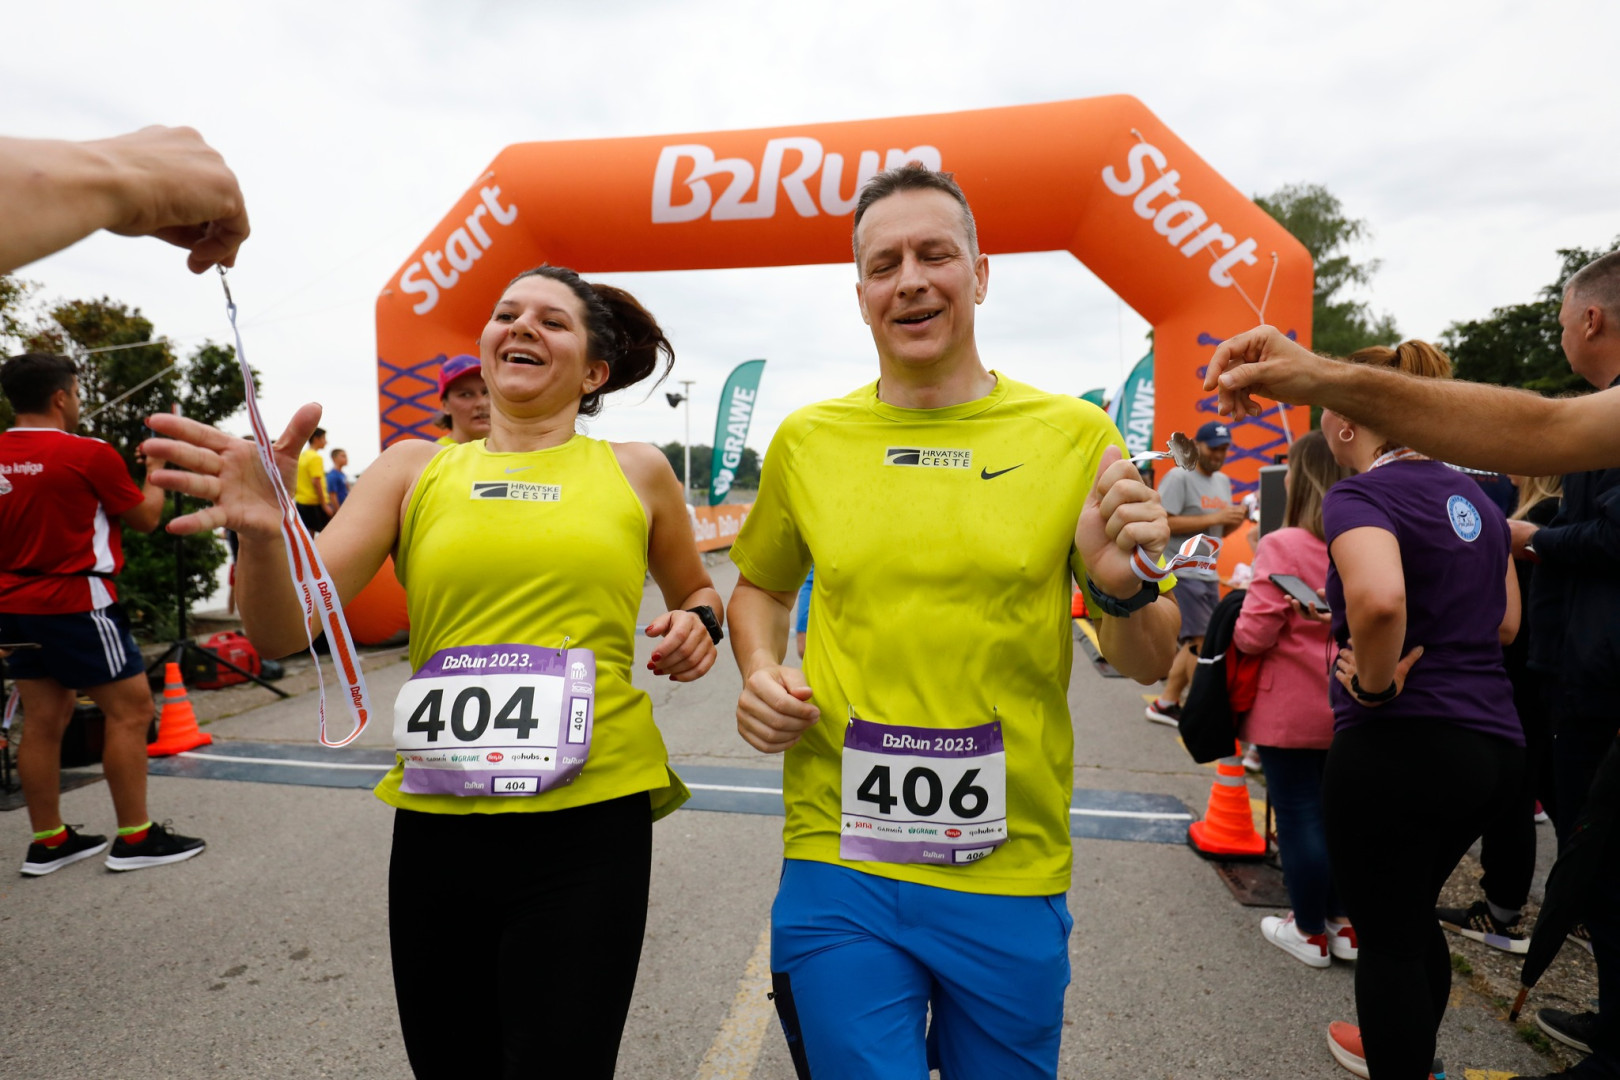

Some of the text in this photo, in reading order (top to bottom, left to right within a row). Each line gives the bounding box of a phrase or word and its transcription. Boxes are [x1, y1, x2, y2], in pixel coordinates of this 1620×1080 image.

[1101, 142, 1258, 288] Start
[400, 183, 518, 315] Start
[722, 386, 755, 469] GRAWE
[1126, 378, 1155, 468] RAWE
[921, 457, 969, 467] CESTE
[922, 450, 970, 458] HRVATSKE
[13, 462, 43, 475] knjiga
[510, 490, 558, 500] CESTE
[511, 483, 559, 493] HRVATSKE
[317, 581, 333, 611] B2Run
[442, 653, 533, 670] B2Run 2023.
[407, 686, 539, 742] 404
[574, 710, 584, 731] 404
[883, 733, 978, 751] B2Run 2023.
[458, 754, 480, 762] GRAWE
[505, 781, 525, 790] 404
[857, 765, 989, 819] 406
[966, 851, 985, 860] 406
